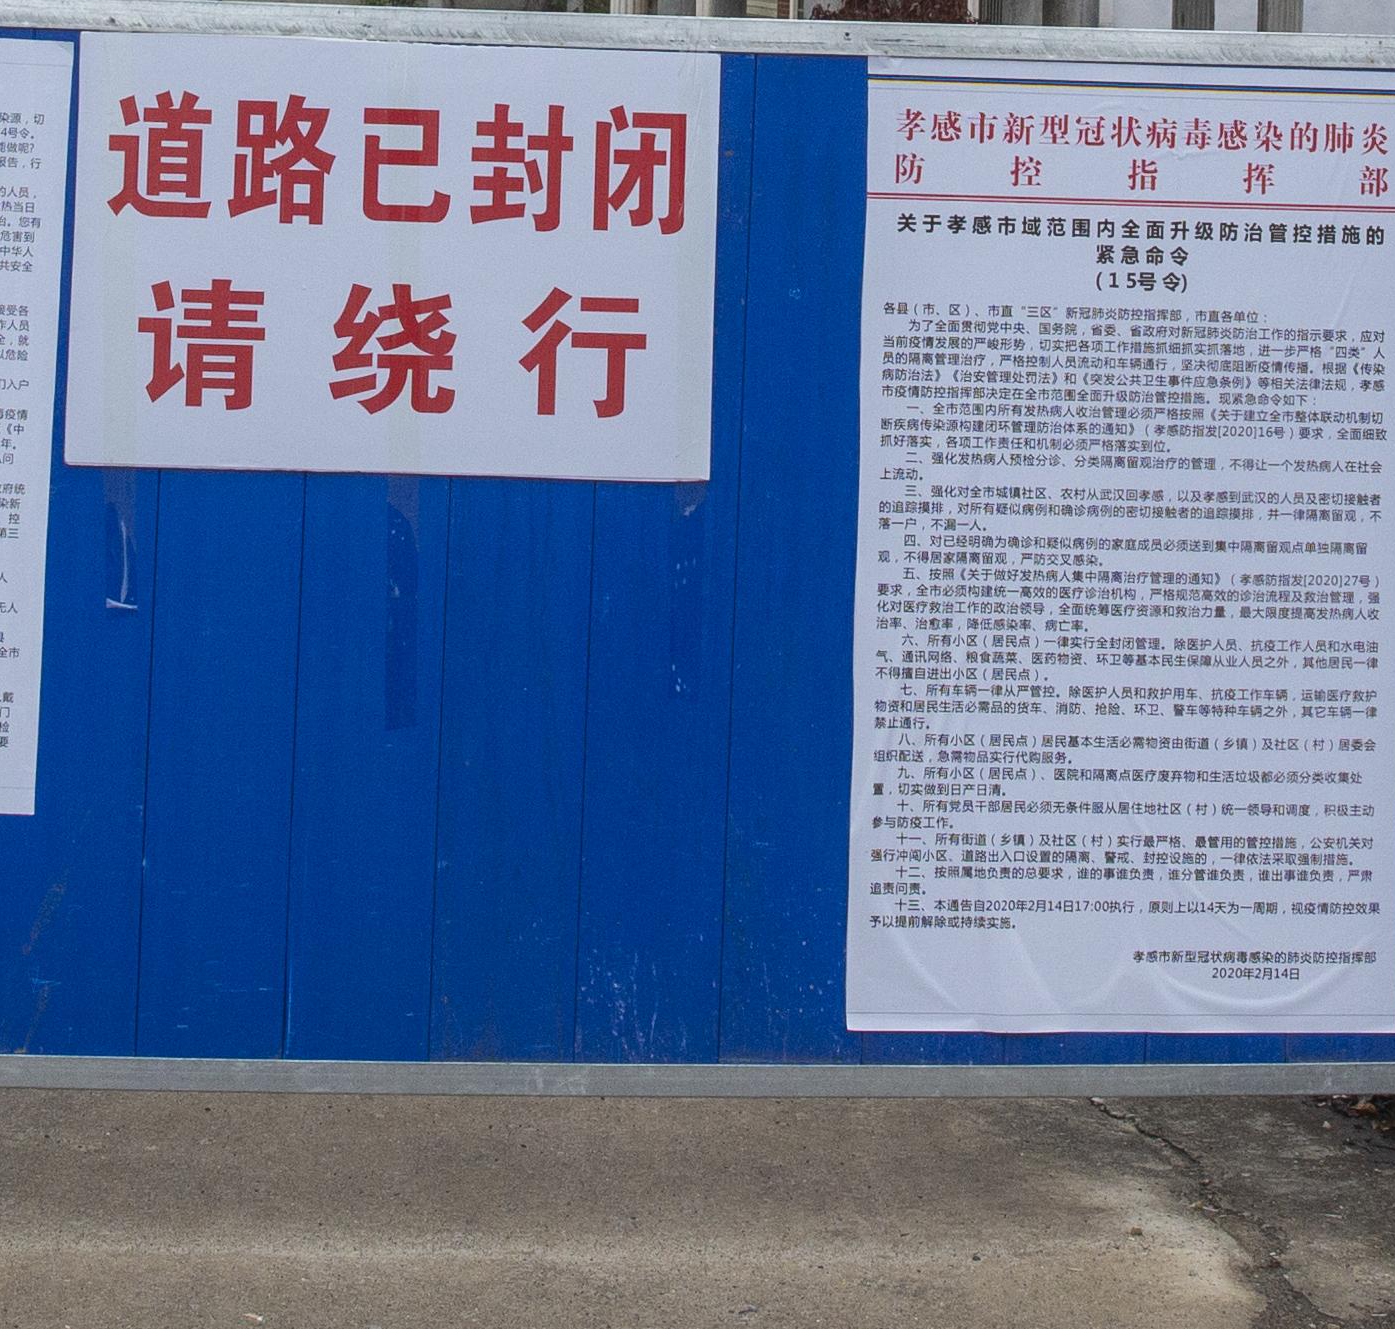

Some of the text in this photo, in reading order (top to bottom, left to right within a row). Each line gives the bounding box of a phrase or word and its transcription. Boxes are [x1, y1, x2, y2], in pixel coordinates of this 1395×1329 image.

[896, 107, 1389, 156] 孝感市新型冠状病毒感染的肺炎
[107, 90, 687, 235] 道路已封闭
[896, 212, 1385, 246] 关于孝感市域范围内全面升级防治管控措施的
[1095, 243, 1190, 267] 紧急命令
[137, 279, 647, 418] 请绕行
[879, 466, 924, 482] 上流动。
[873, 715, 931, 731] 禁止通行。
[871, 814, 954, 830] 参与防疫工作。
[869, 881, 927, 896] 追责问责。
